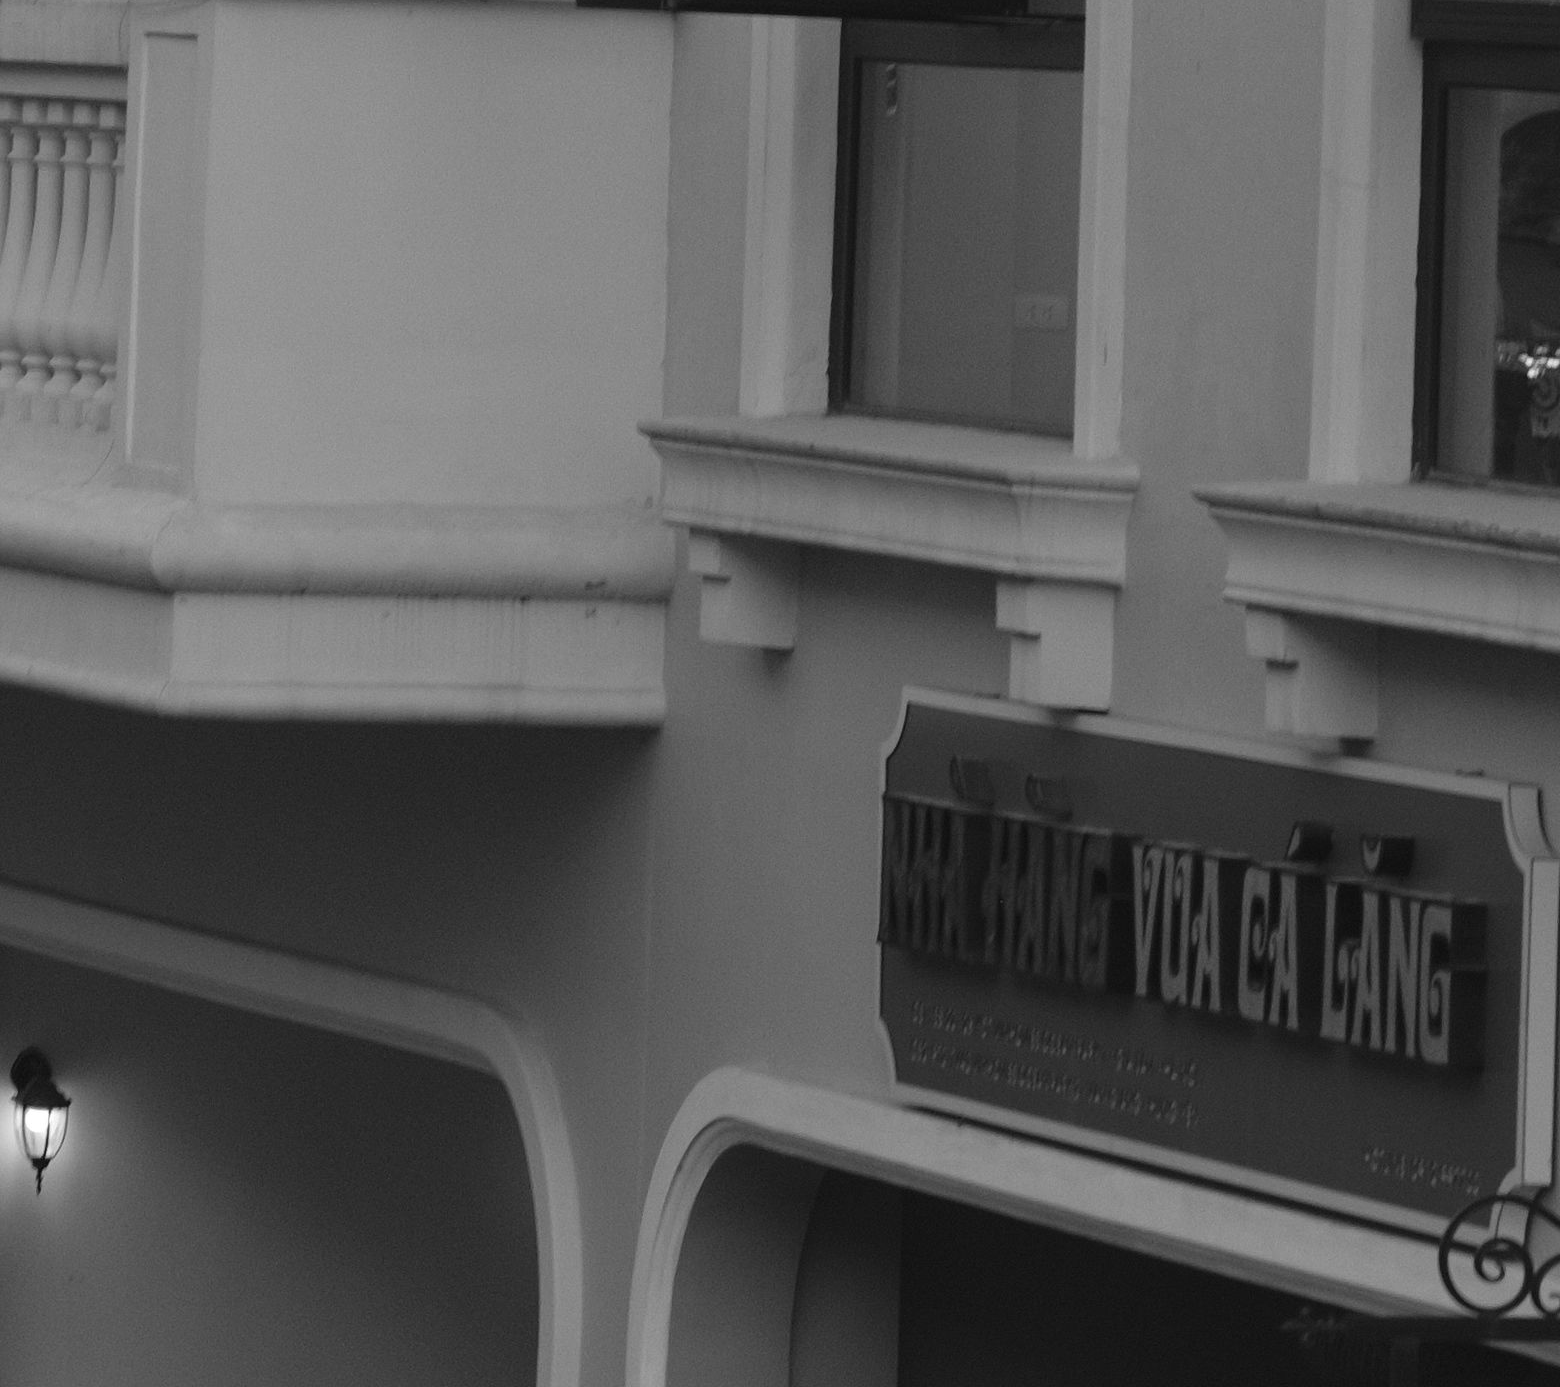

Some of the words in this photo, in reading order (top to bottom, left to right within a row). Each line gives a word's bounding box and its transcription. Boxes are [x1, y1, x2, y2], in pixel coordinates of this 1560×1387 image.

[1132, 843, 1222, 1013] VUA
[1237, 820, 1300, 1031] CÁ
[1319, 835, 1455, 1066] LĂNG
